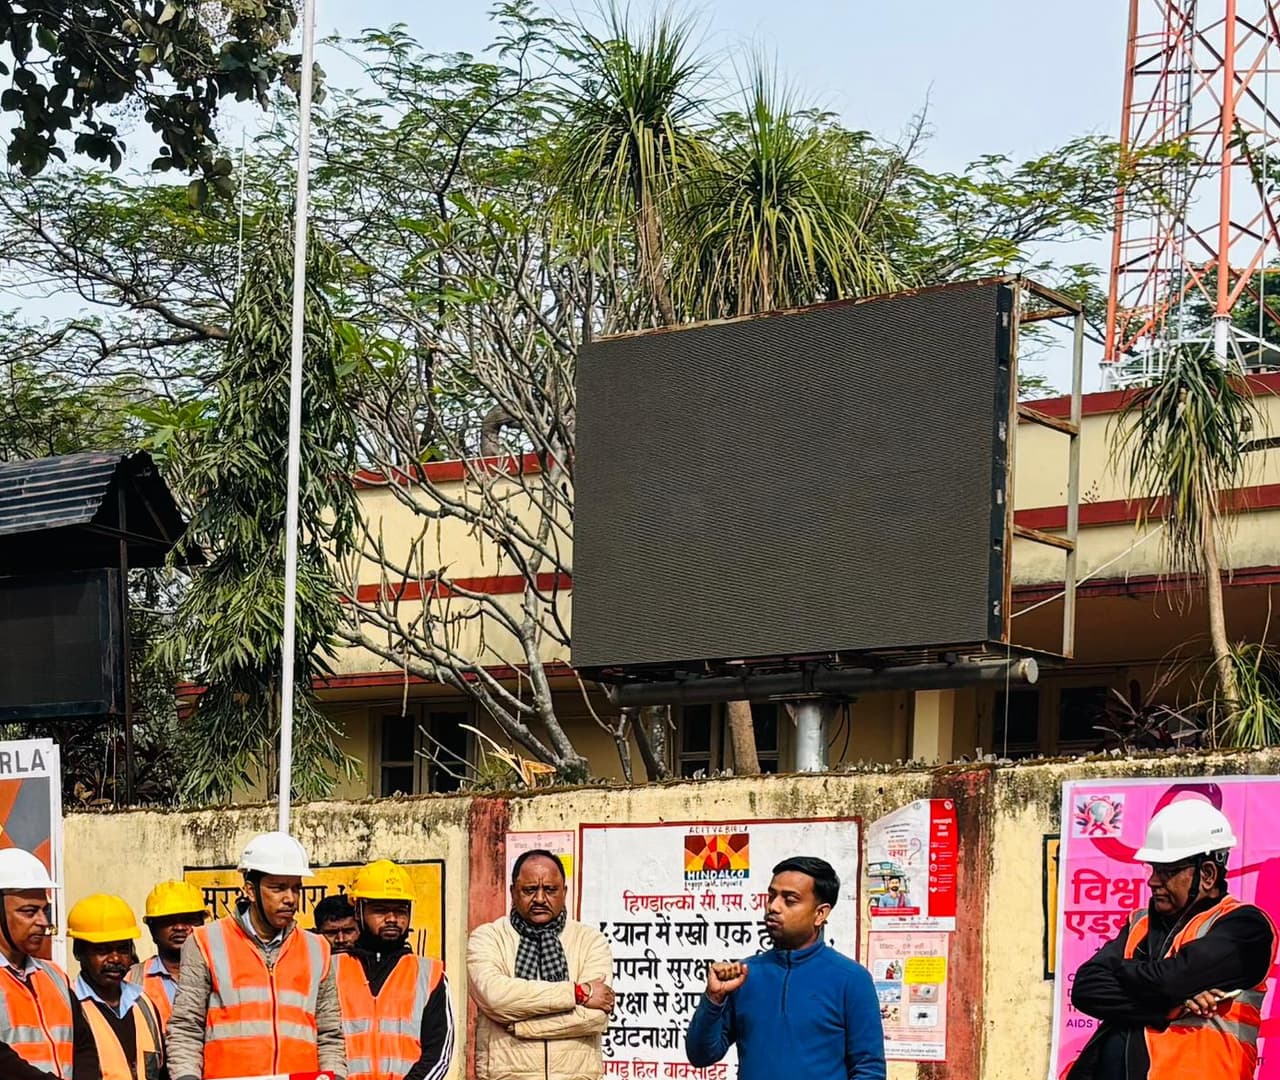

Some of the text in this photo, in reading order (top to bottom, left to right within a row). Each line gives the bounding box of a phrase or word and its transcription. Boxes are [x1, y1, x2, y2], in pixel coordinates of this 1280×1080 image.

[688, 869, 745, 880] HINDALCO
[1071, 868, 1146, 910] विश्व
[655, 914, 672, 947] में
[675, 914, 709, 947] रखो
[714, 921, 752, 948] एक
[653, 984, 670, 1016] से
[1066, 1018, 1093, 1028] AIDS
[632, 1056, 659, 1080] हिल
